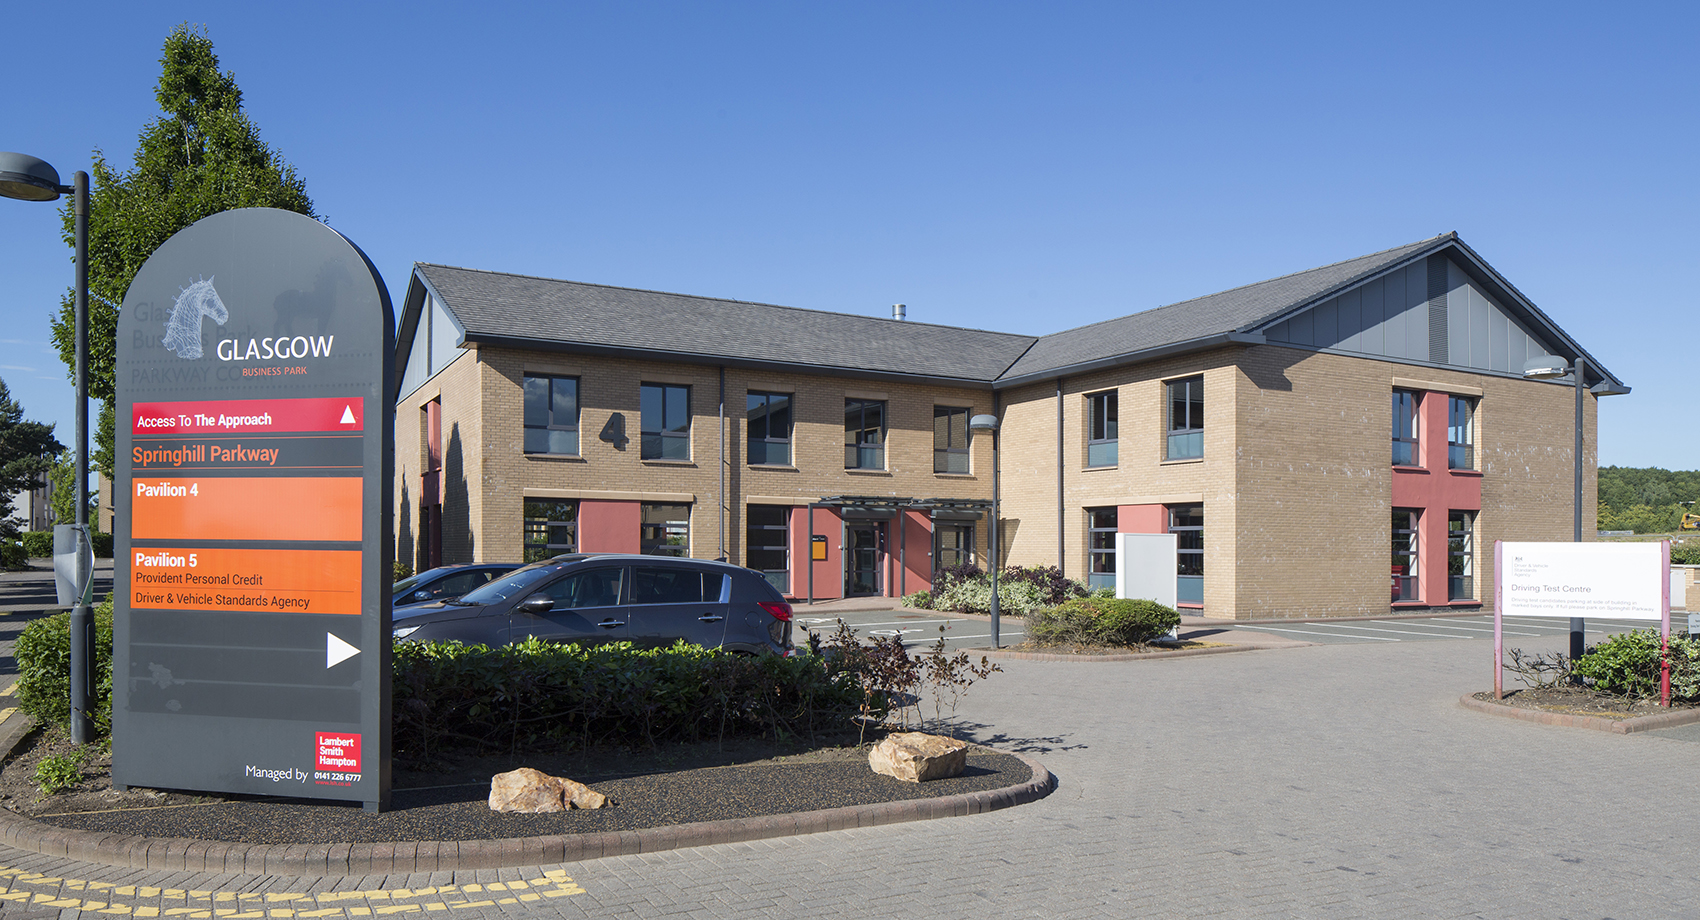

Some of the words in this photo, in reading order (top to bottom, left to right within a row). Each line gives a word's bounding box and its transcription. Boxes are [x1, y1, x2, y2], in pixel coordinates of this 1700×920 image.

[216, 336, 334, 361] GLASGOW
[131, 366, 210, 384] PARKWAY
[242, 367, 282, 377] BUSINESS
[284, 366, 307, 375] PARK
[137, 415, 176, 428] Access
[178, 415, 191, 426] To
[194, 414, 215, 426] The
[218, 412, 272, 429] Approach
[599, 412, 627, 448] 4
[132, 445, 205, 467] Springhill
[210, 444, 279, 466] Parkway
[137, 483, 187, 496] Pavilion
[190, 483, 199, 496] 4
[135, 553, 185, 567] Pavilion
[189, 554, 197, 568] 5
[136, 572, 183, 584] Provident
[185, 573, 230, 585] Personal
[233, 574, 263, 585] Credit
[1511, 584, 1540, 593] Driving
[1562, 585, 1591, 593] Centre
[135, 593, 165, 604] Driver
[167, 593, 174, 604] &
[176, 593, 213, 605] Vehicle
[215, 594, 268, 606] Standards
[271, 596, 310, 610] Agency
[319, 736, 354, 747] Lambert
[319, 746, 343, 756] Smith
[319, 756, 356, 767] Hampton
[245, 765, 293, 783] Managed
[295, 768, 308, 783] by
